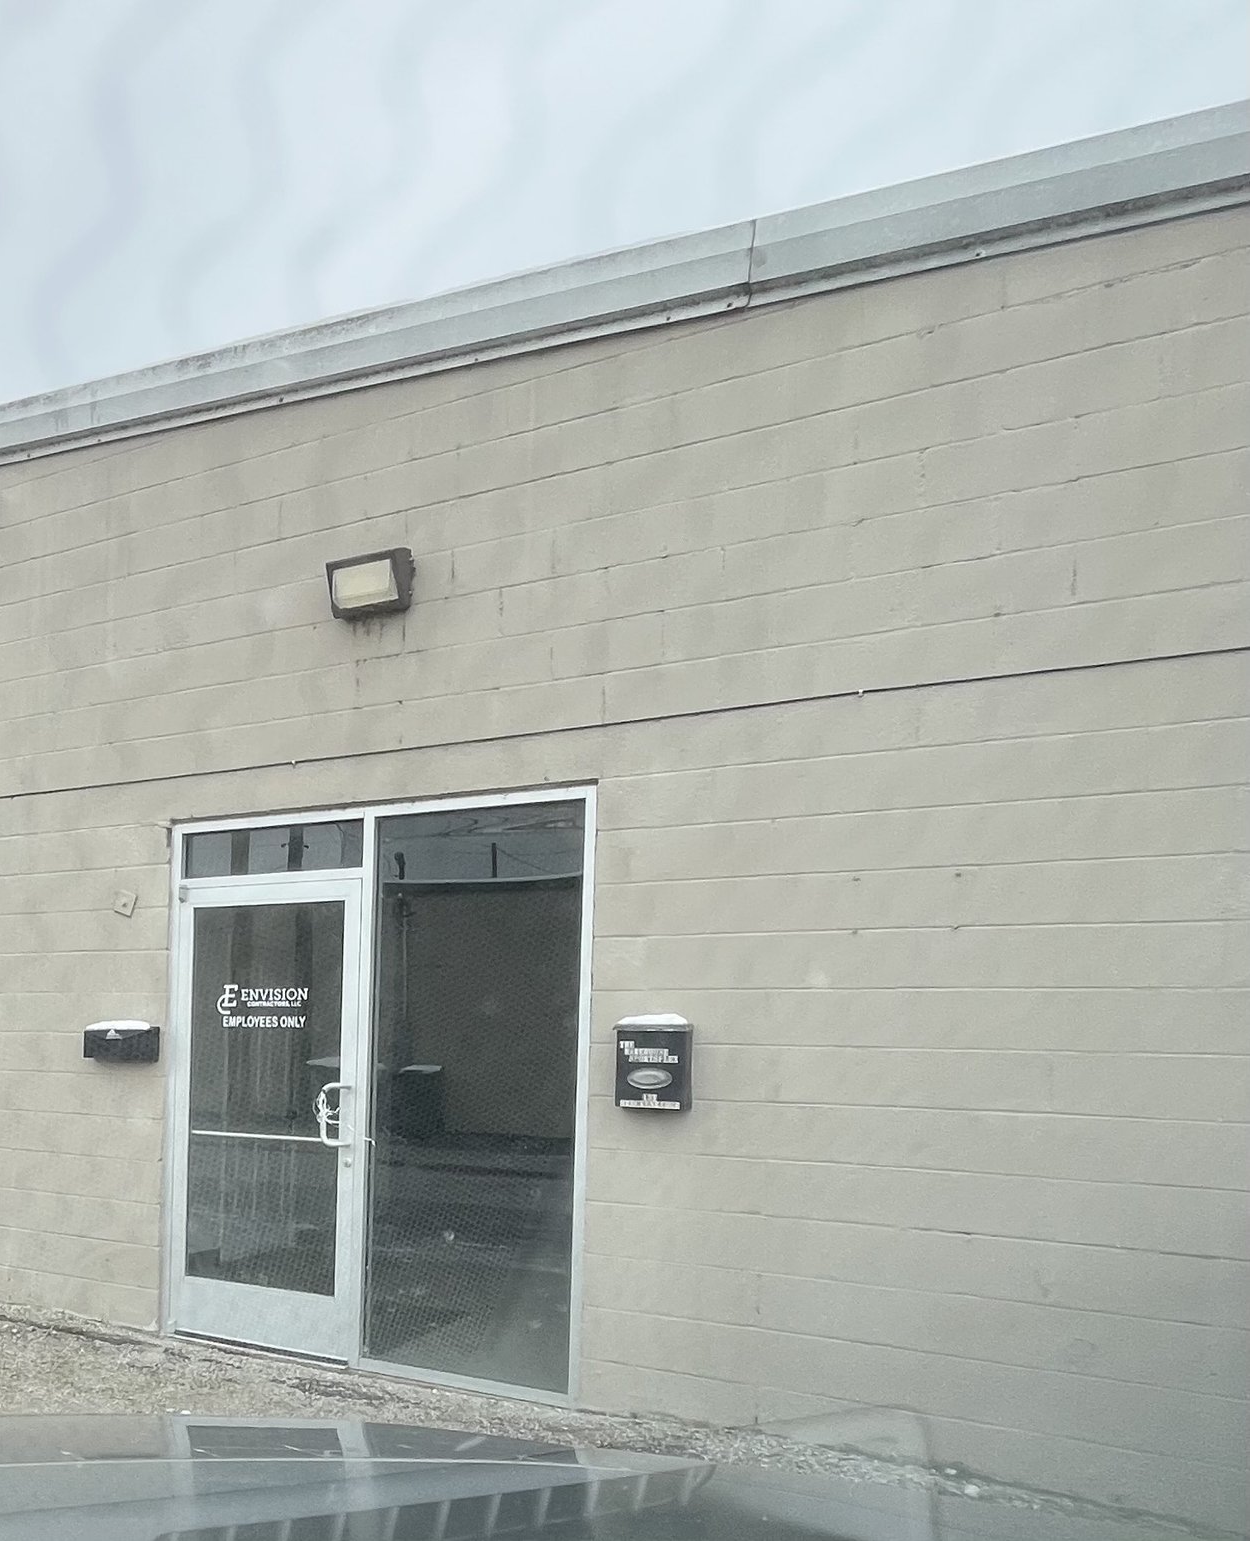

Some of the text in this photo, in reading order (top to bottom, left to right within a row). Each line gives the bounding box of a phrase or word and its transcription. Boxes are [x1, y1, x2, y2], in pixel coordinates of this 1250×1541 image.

[240, 987, 309, 1001] ENVISION
[222, 1015, 306, 1028] EMPLOYEES ONLY
